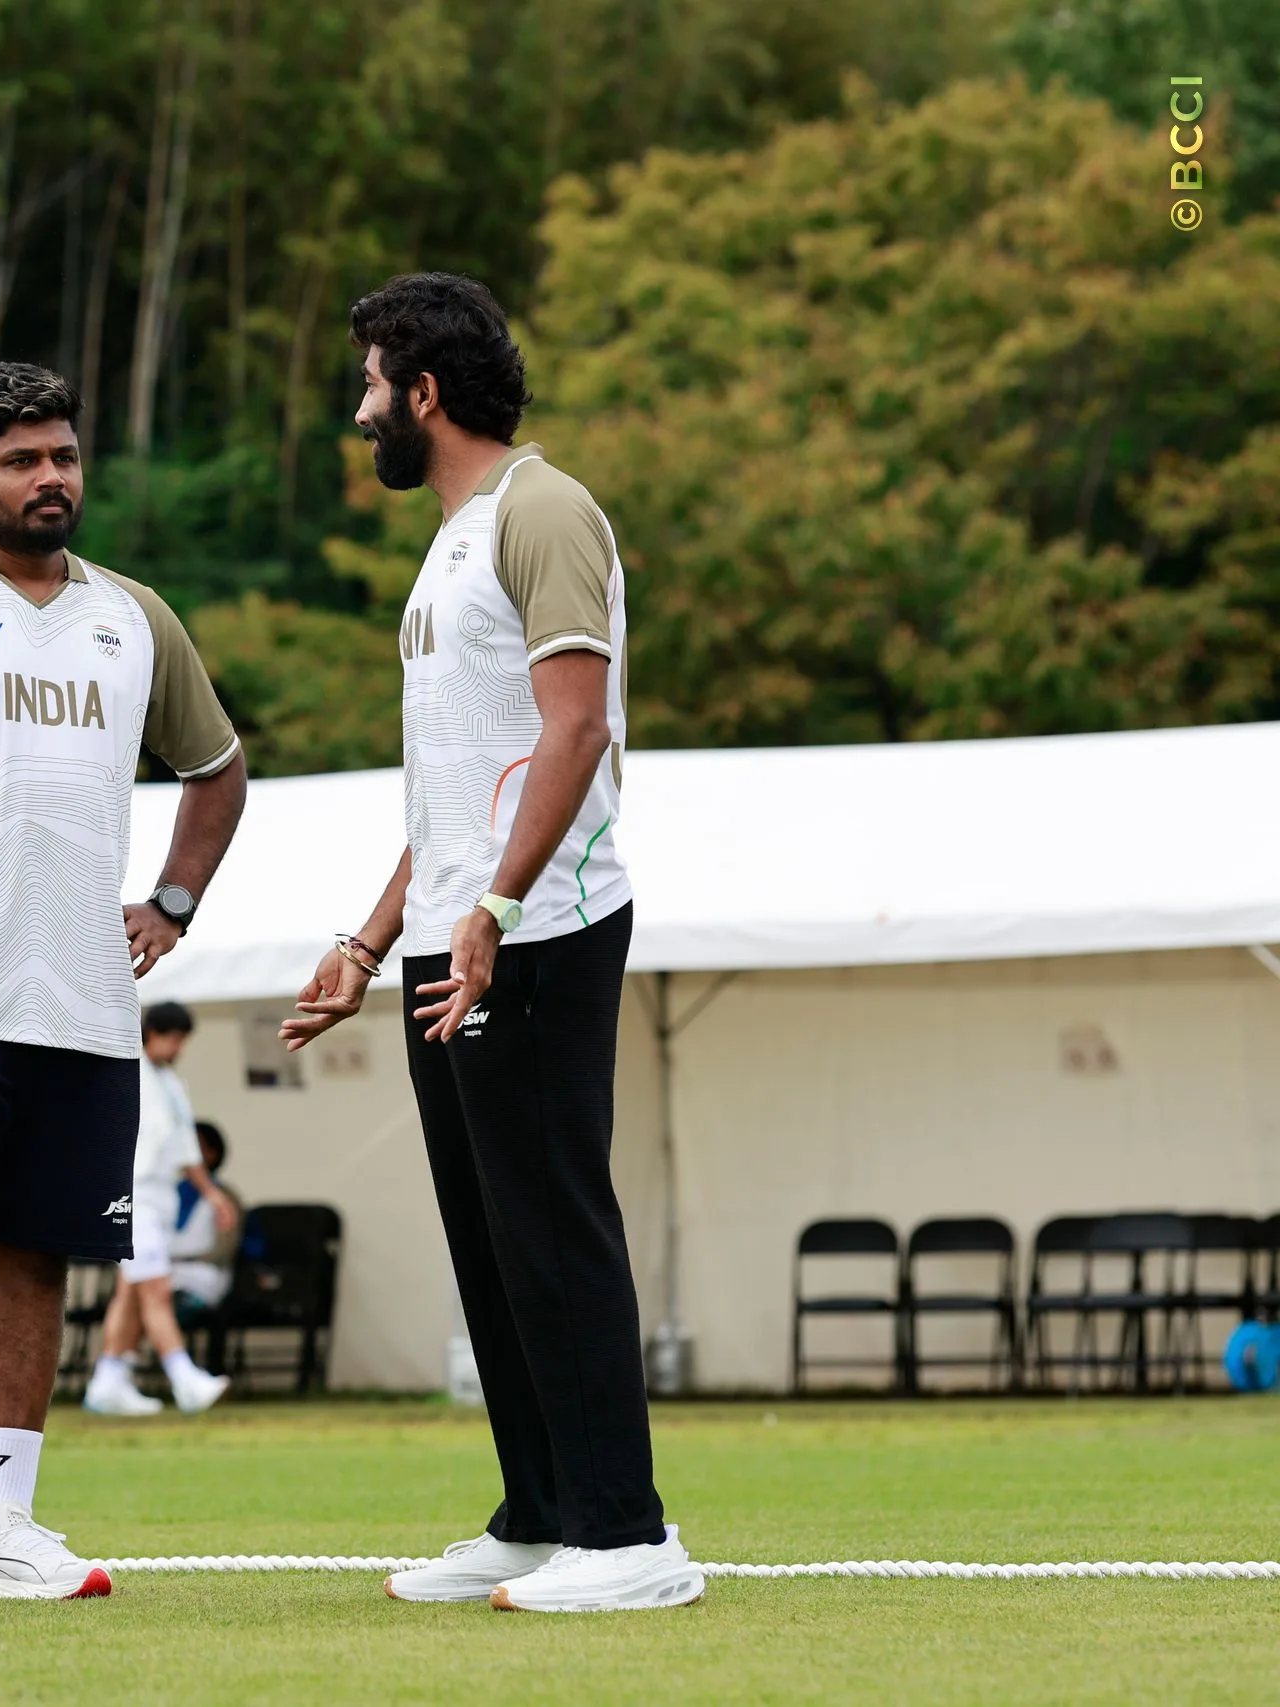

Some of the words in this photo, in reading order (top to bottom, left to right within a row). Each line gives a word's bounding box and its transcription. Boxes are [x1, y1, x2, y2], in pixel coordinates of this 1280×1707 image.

[92, 633, 122, 648] INDIA
[3, 672, 106, 730] INDIA
[457, 1011, 490, 1030] SW
